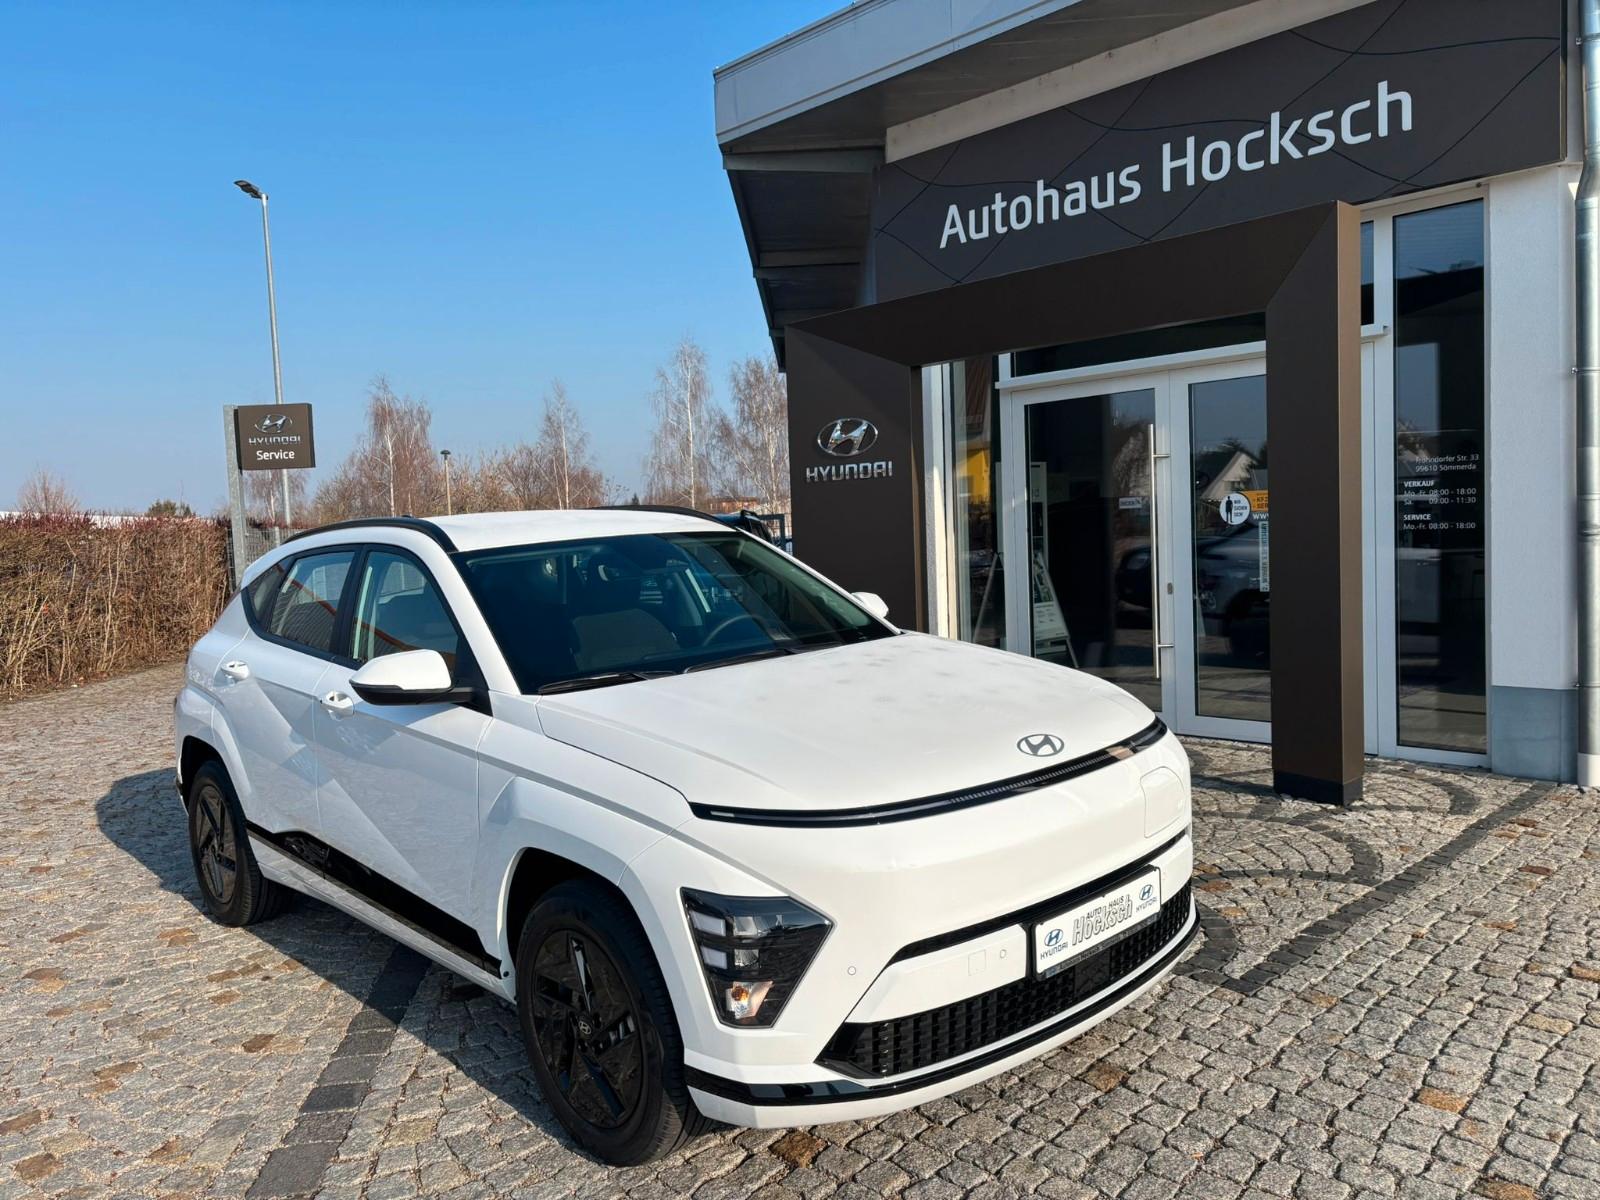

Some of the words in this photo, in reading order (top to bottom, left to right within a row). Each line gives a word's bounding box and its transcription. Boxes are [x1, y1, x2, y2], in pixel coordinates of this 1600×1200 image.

[939, 163, 1142, 249] Autohaus
[1162, 80, 1412, 192] Hocksch
[248, 434, 301, 446] HYUNDAI
[256, 449, 295, 461] Service
[1456, 454, 1468, 462] Str.
[806, 460, 893, 482] HYUNDAI
[1415, 464, 1438, 473] 99610
[1439, 463, 1477, 471] Sömmerda
[1403, 480, 1435, 488] VERKAUF
[1429, 489, 1449, 497] 08:00
[1456, 488, 1477, 496] 18:00
[1429, 497, 1449, 505] 09:00
[1456, 496, 1477, 504] 11:30
[1403, 513, 1432, 521] SERVICE
[1429, 522, 1449, 530] 08:00
[1455, 521, 1476, 529] 18:00
[1086, 906, 1102, 919] AUTO
[1108, 895, 1125, 908] HAUS
[1072, 894, 1133, 946] Hocksch
[1040, 941, 1068, 960] HYUNDAI
